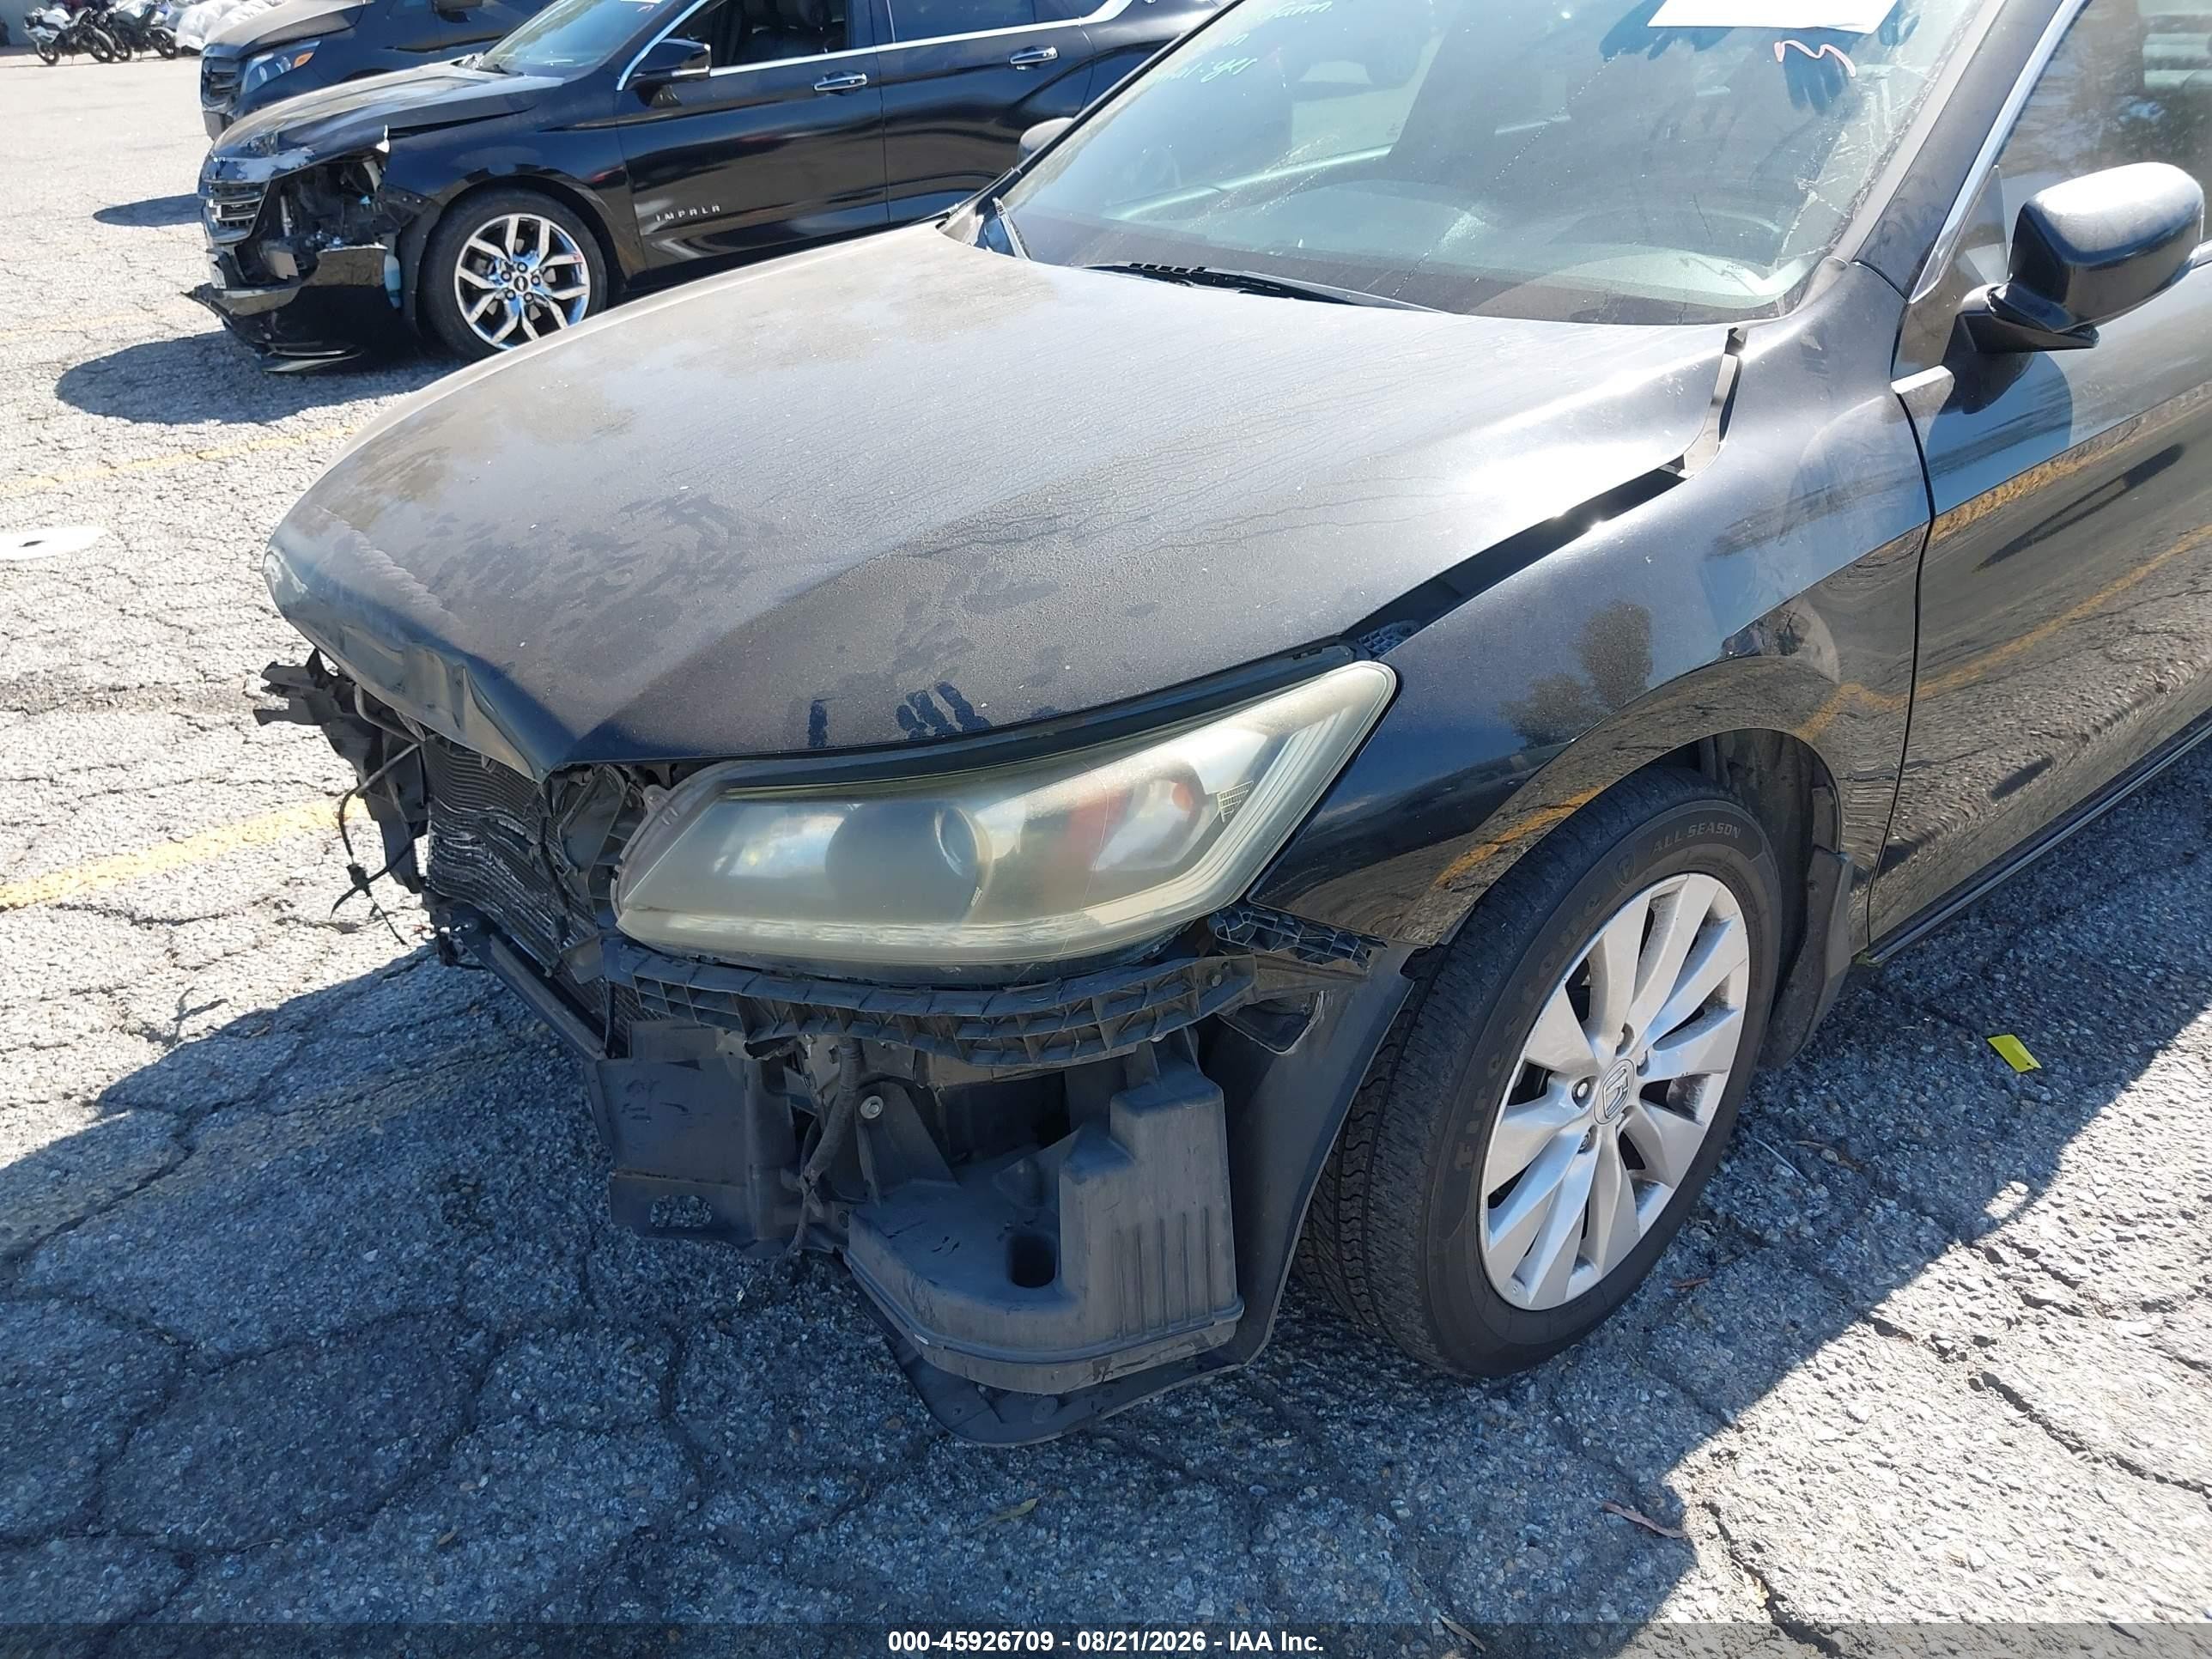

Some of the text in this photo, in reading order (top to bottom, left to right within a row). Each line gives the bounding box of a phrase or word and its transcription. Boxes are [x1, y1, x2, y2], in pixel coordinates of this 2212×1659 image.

[655, 204, 720, 222] IMPALA
[1651, 822, 1741, 855] ALL SEASON
